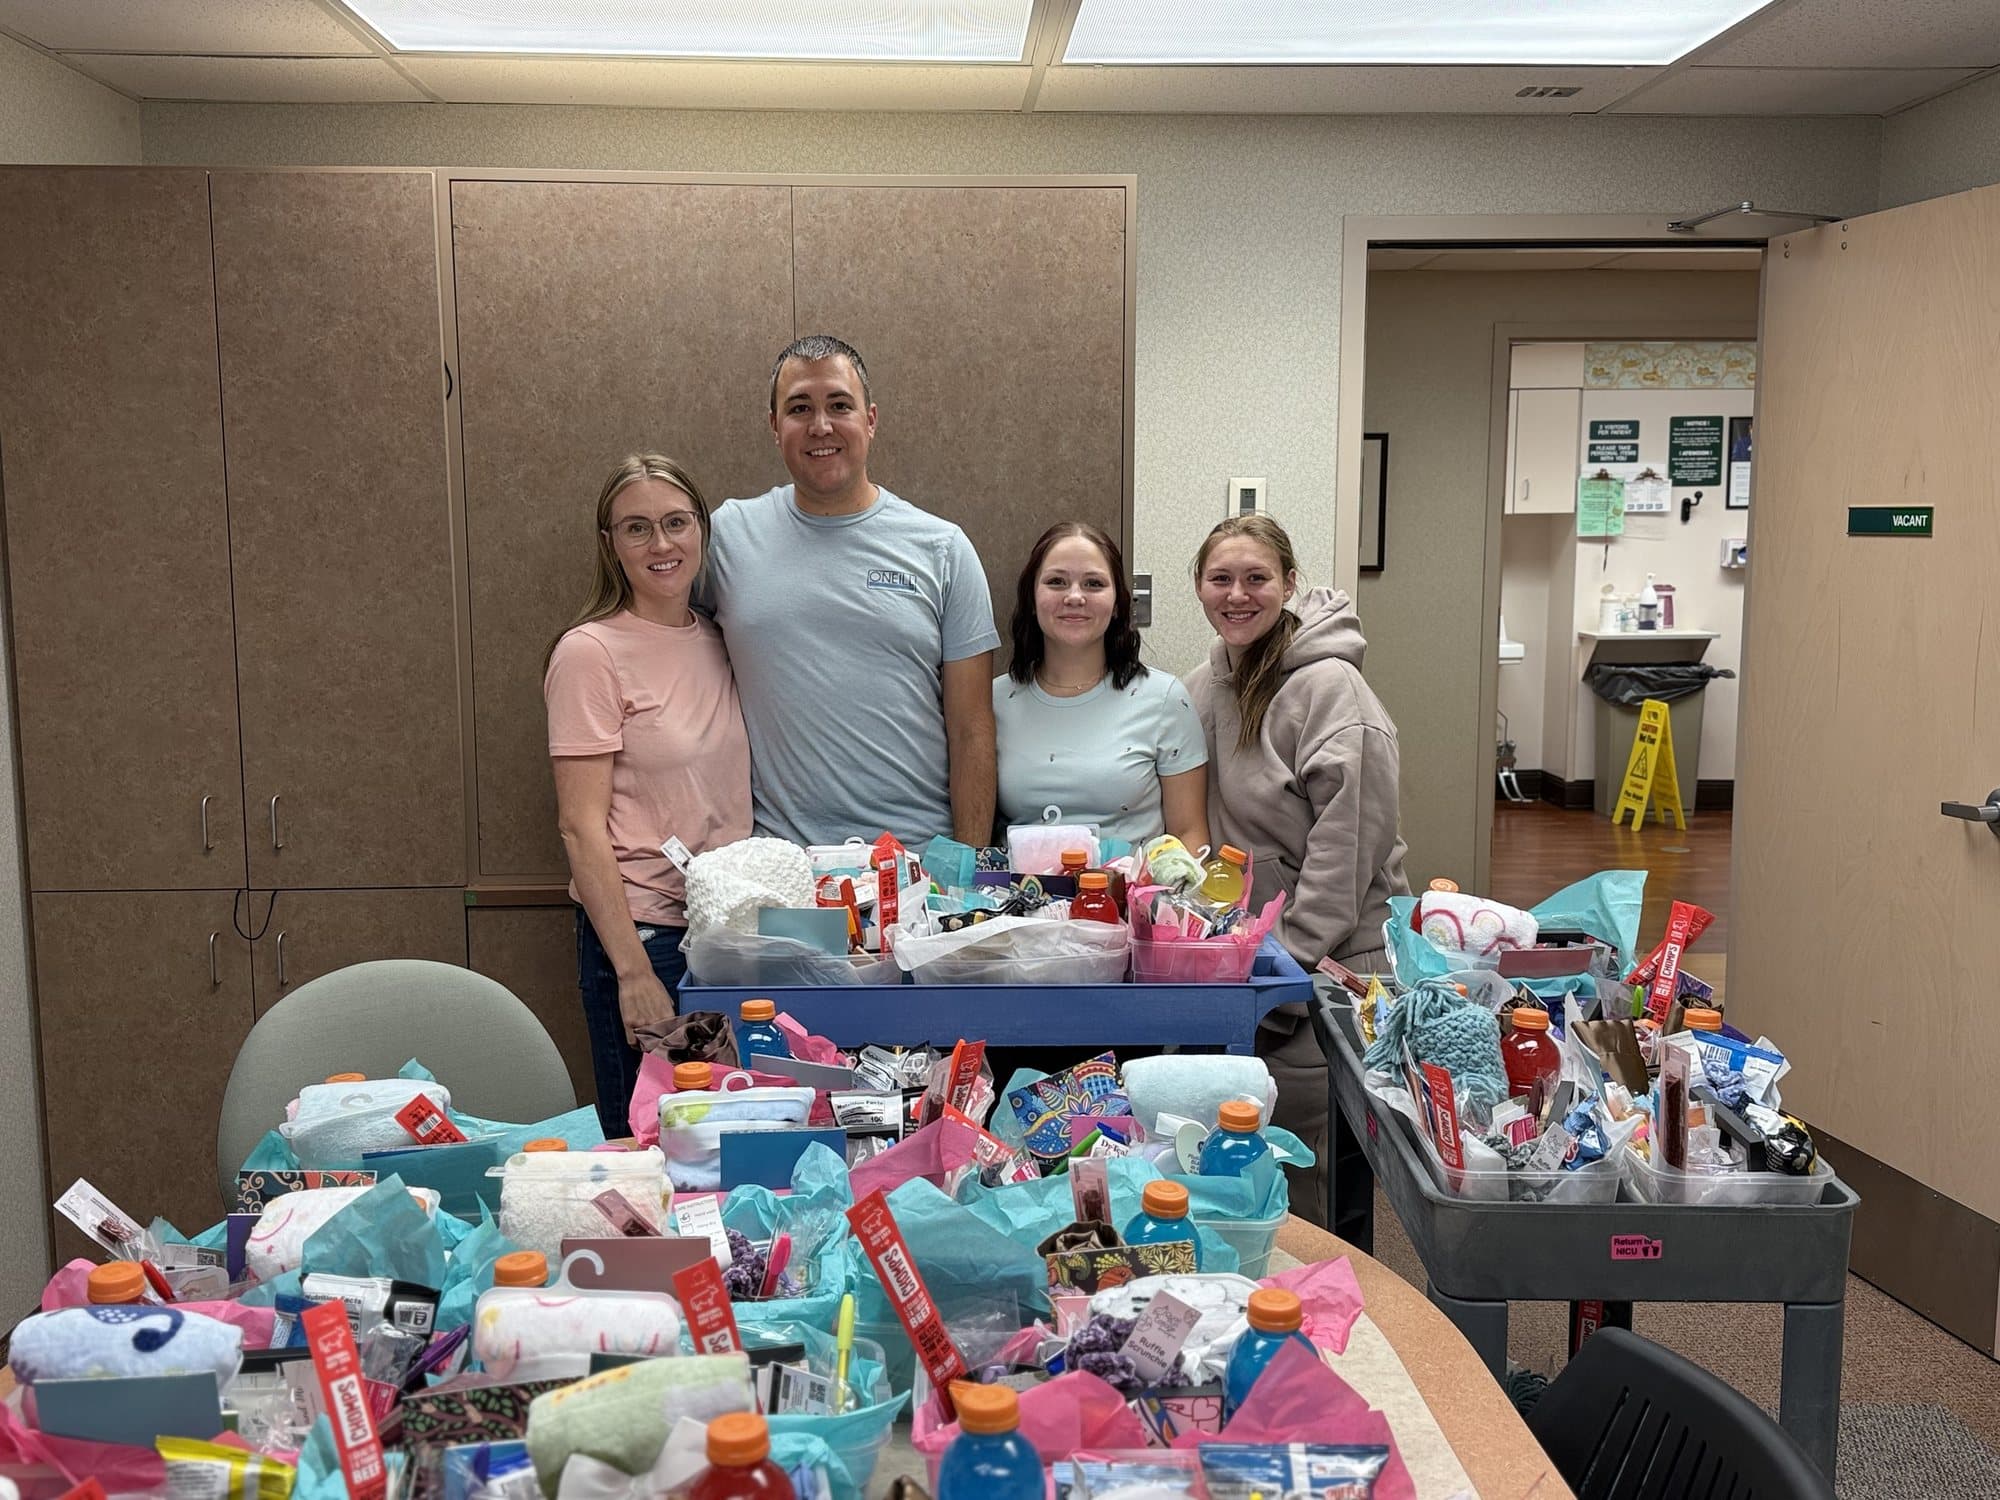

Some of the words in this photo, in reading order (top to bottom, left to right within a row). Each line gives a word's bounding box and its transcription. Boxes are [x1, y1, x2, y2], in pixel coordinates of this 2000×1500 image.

[1892, 514, 1928, 527] VACANT
[1661, 945, 1679, 978] CHOMPS
[1613, 1238, 1643, 1246] Return
[1615, 1247, 1638, 1256] NICU
[884, 1248, 917, 1297] CHOMPS
[1127, 1339, 1168, 1369] Scrunchie
[1139, 1335, 1166, 1357] Ruffle
[338, 1380, 368, 1443] CHOMPS
